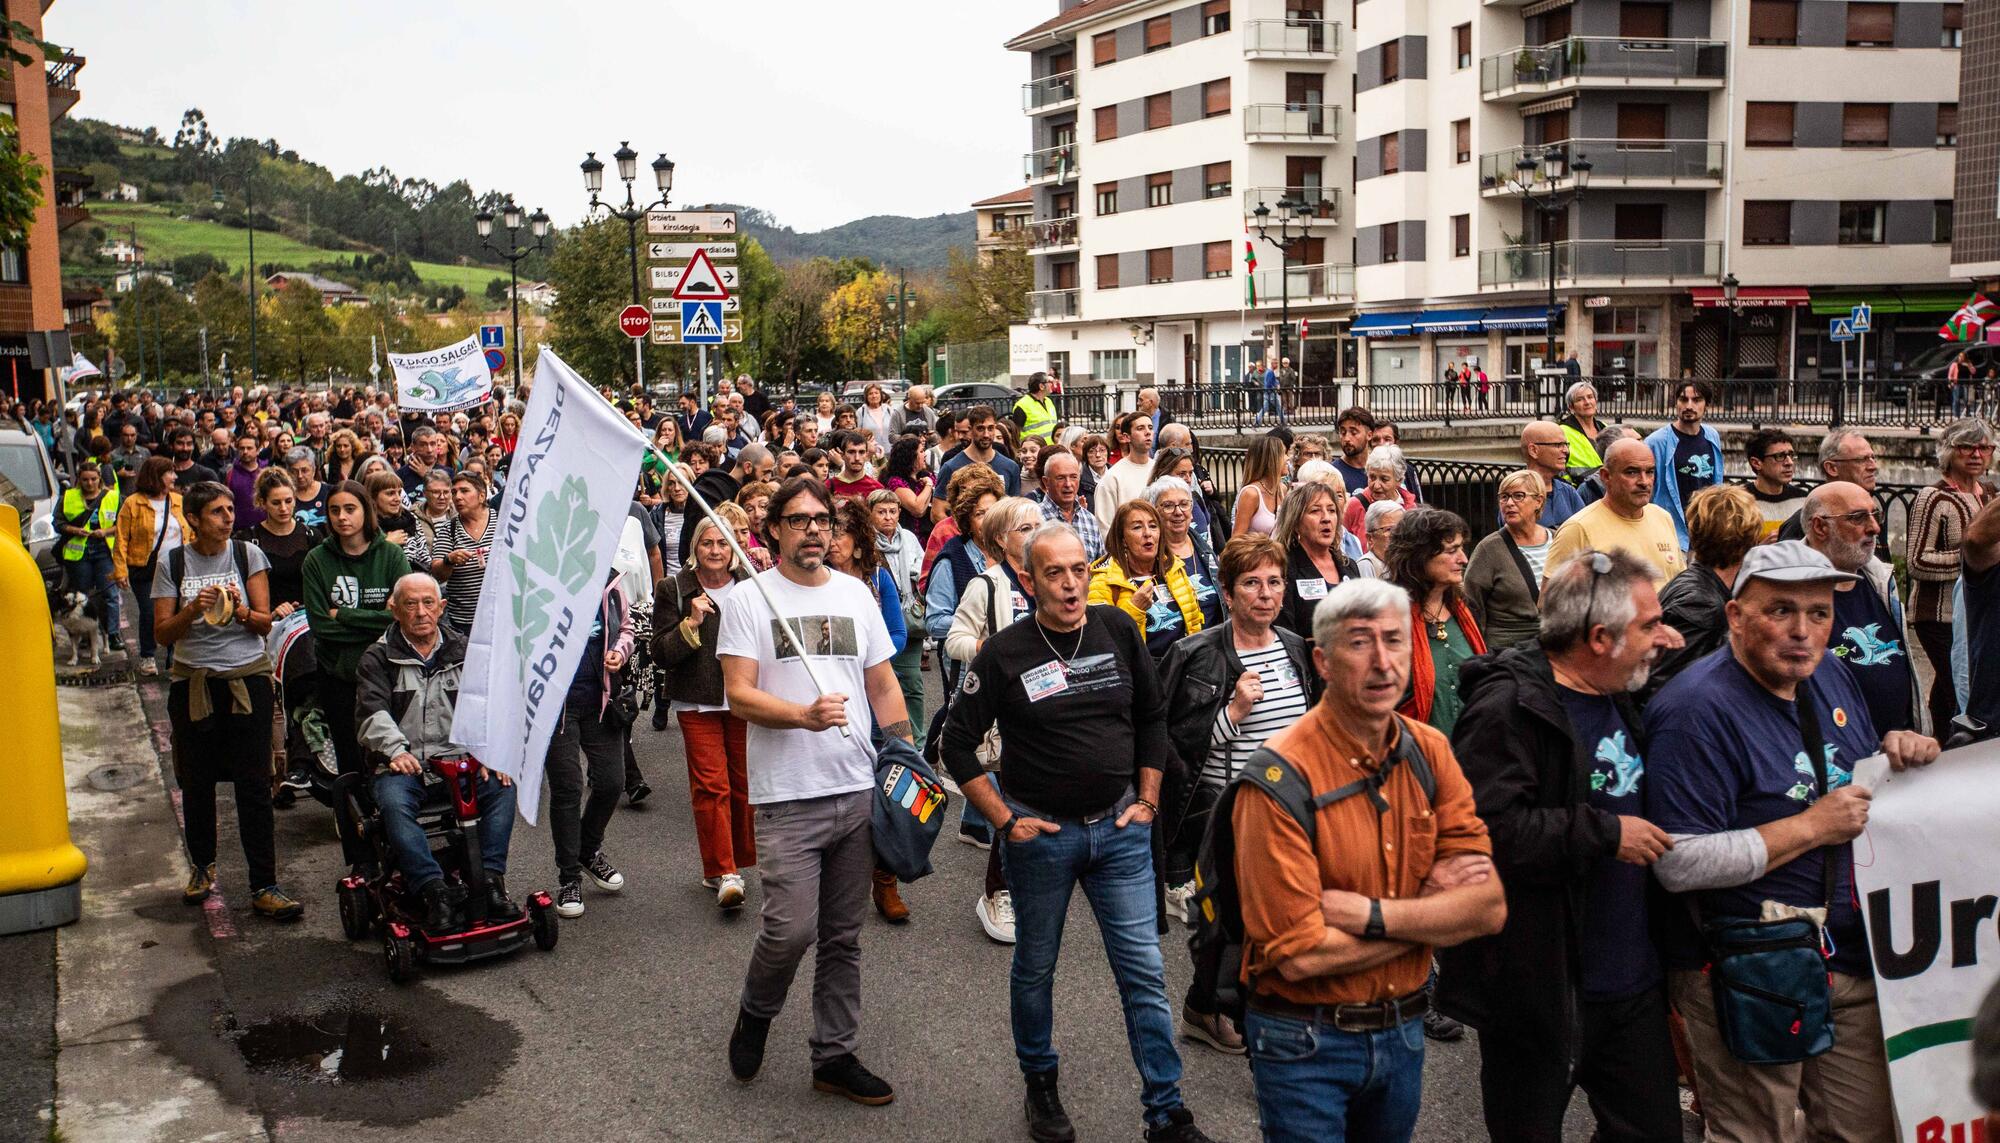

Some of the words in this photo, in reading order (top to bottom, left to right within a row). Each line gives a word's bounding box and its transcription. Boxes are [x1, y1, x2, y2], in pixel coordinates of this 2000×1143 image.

[623, 317, 649, 326] STOP
[408, 356, 439, 366] DAGO
[1868, 879, 2000, 980] Ur
